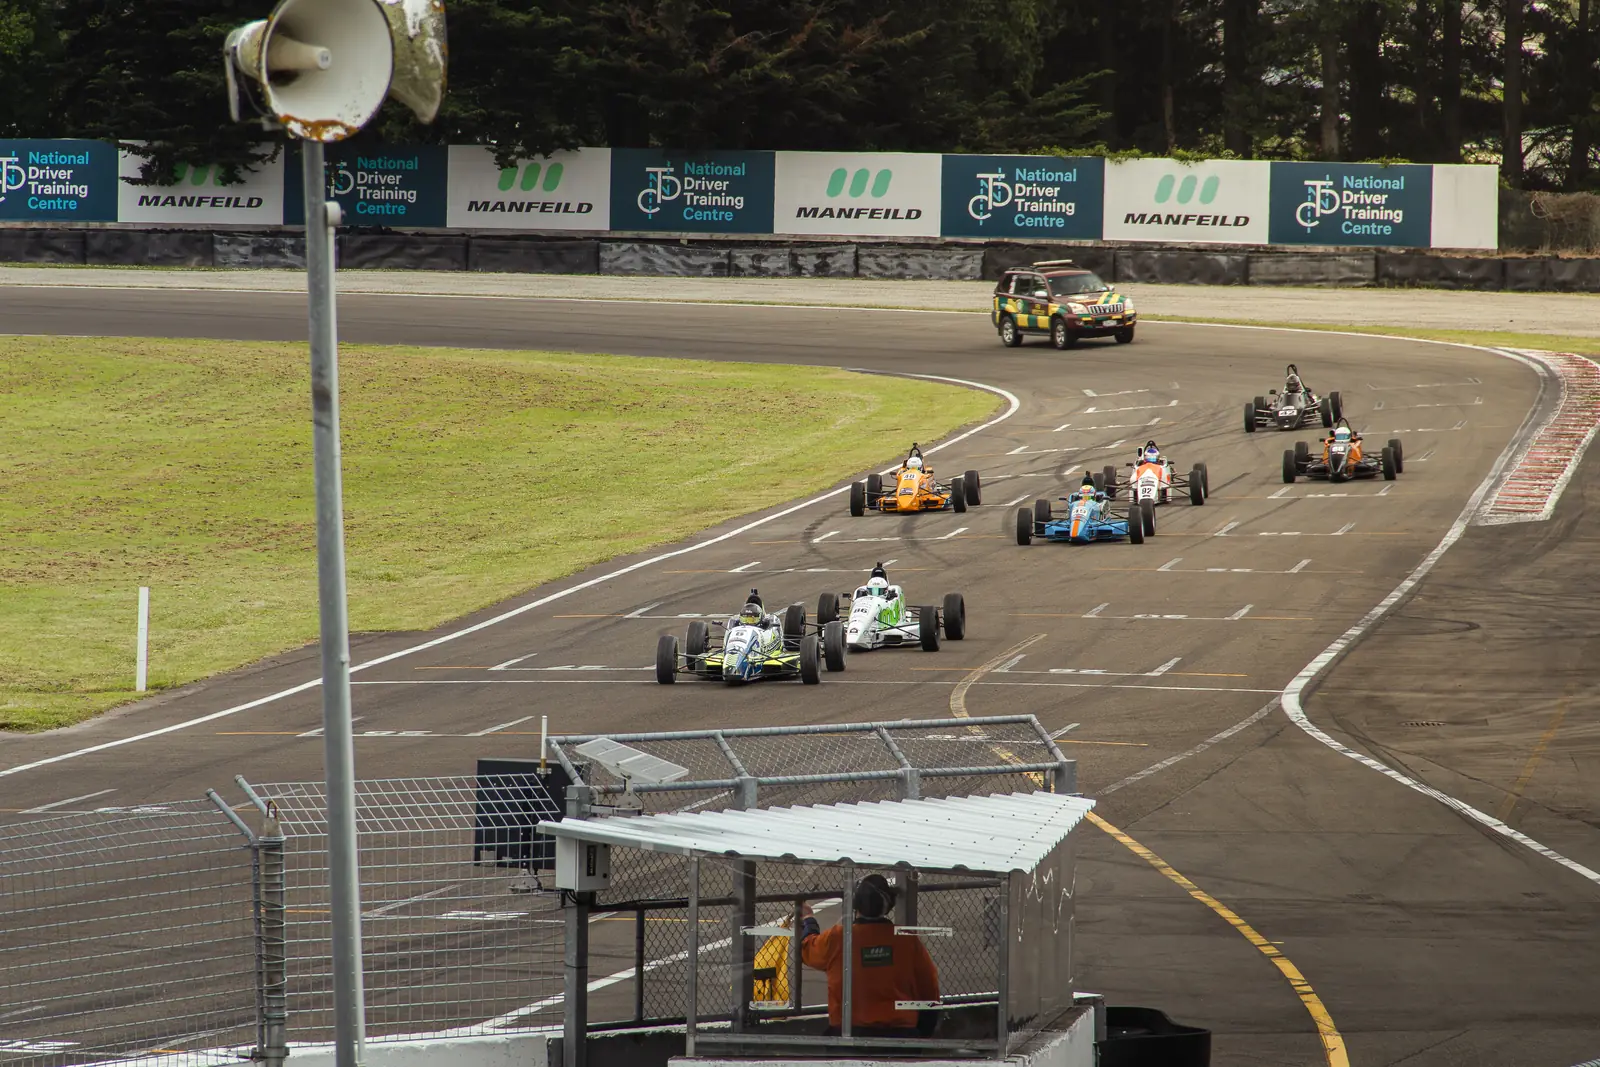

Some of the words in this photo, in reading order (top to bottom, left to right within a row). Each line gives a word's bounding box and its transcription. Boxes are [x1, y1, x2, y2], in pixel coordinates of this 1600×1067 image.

[29, 152, 88, 164] National
[358, 157, 417, 169] National
[29, 167, 72, 179] Driver
[685, 163, 744, 176] National
[1016, 169, 1076, 181] National
[358, 172, 401, 184] Driver
[685, 178, 729, 190] Driver
[1344, 176, 1404, 189] National
[28, 182, 87, 197] Training
[357, 187, 416, 202] Training
[1016, 184, 1060, 196] Driver
[28, 197, 76, 209] Centre
[139, 196, 263, 208] MANFEILD
[684, 193, 743, 210] Training
[1343, 191, 1387, 204] Driver
[357, 202, 405, 214] Centre
[468, 201, 592, 213] MANFEILD
[797, 207, 921, 219] MANFEILD
[1015, 199, 1074, 216] Training
[684, 208, 732, 220] Centre
[1124, 214, 1249, 226] MANFEILD
[1342, 206, 1402, 223] Training
[1015, 214, 1063, 227] Centre
[1342, 221, 1391, 234] Centre
[1142, 487, 1152, 495] 92
